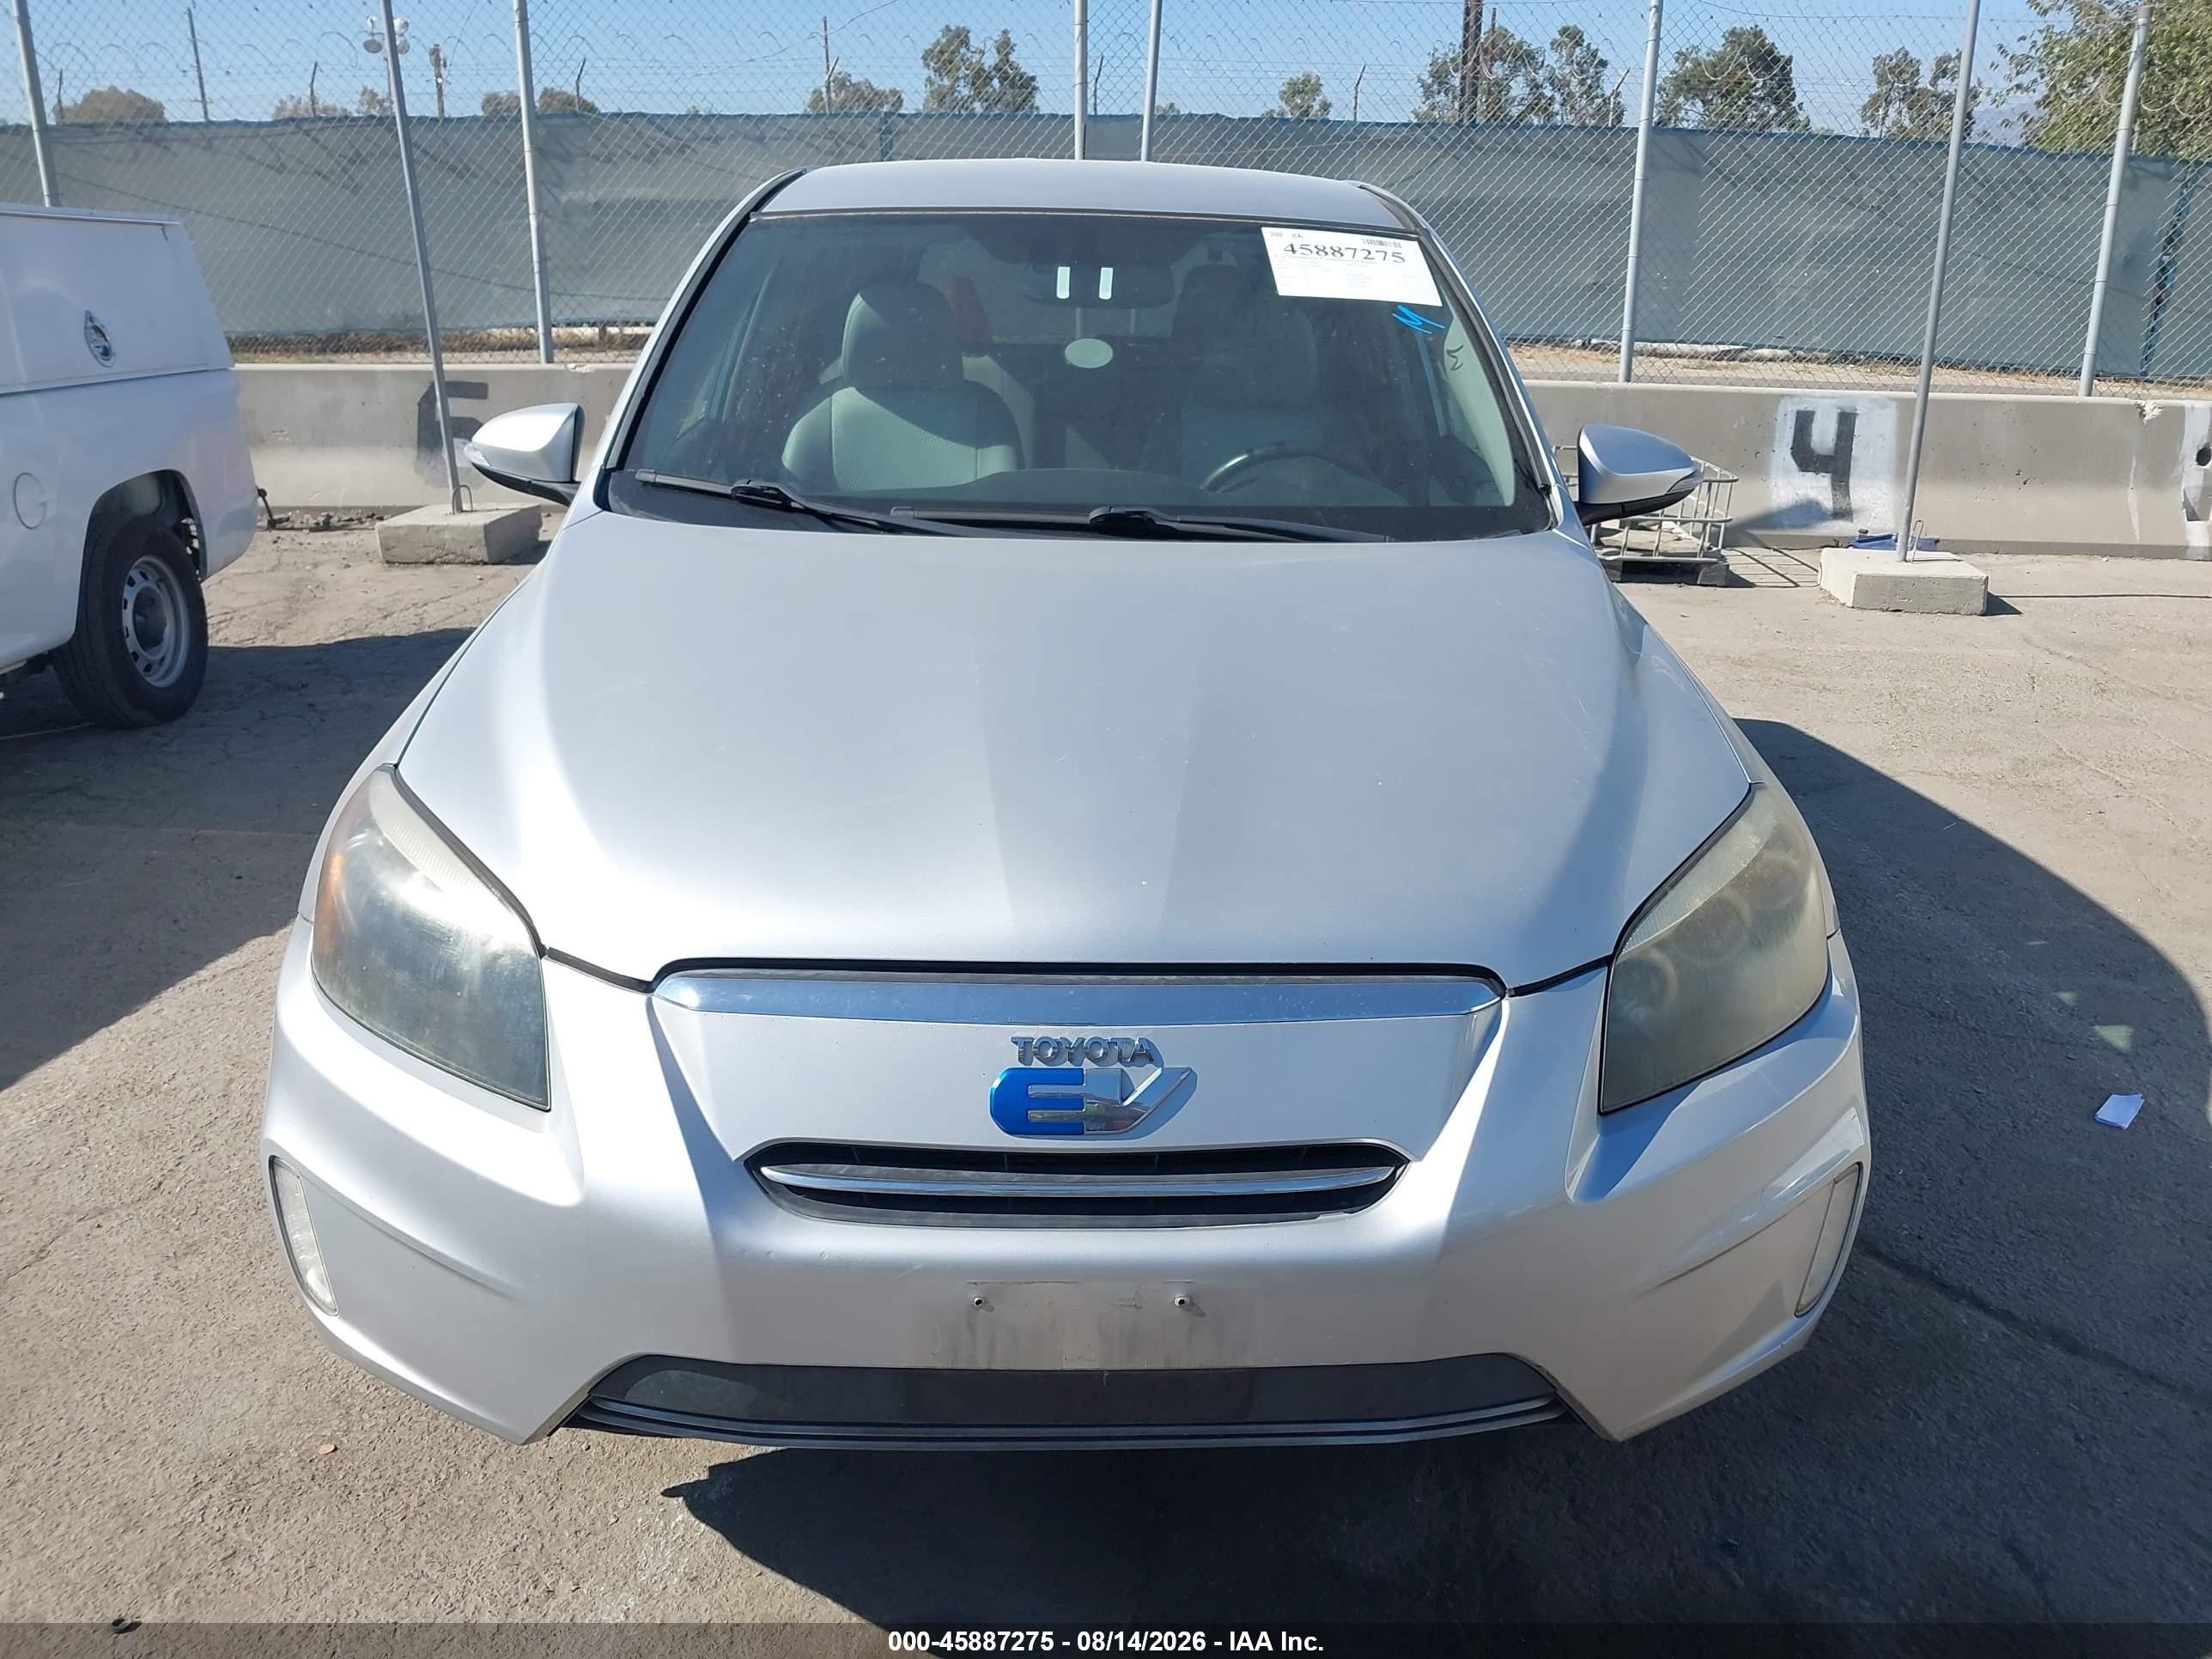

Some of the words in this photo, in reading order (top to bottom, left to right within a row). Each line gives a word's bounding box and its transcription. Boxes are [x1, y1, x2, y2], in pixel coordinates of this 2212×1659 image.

[1282, 242, 1407, 264] 45887275
[1790, 410, 1857, 522] 4
[1011, 1036, 1161, 1066] TOYOTA
[988, 1066, 1197, 1139] EV
